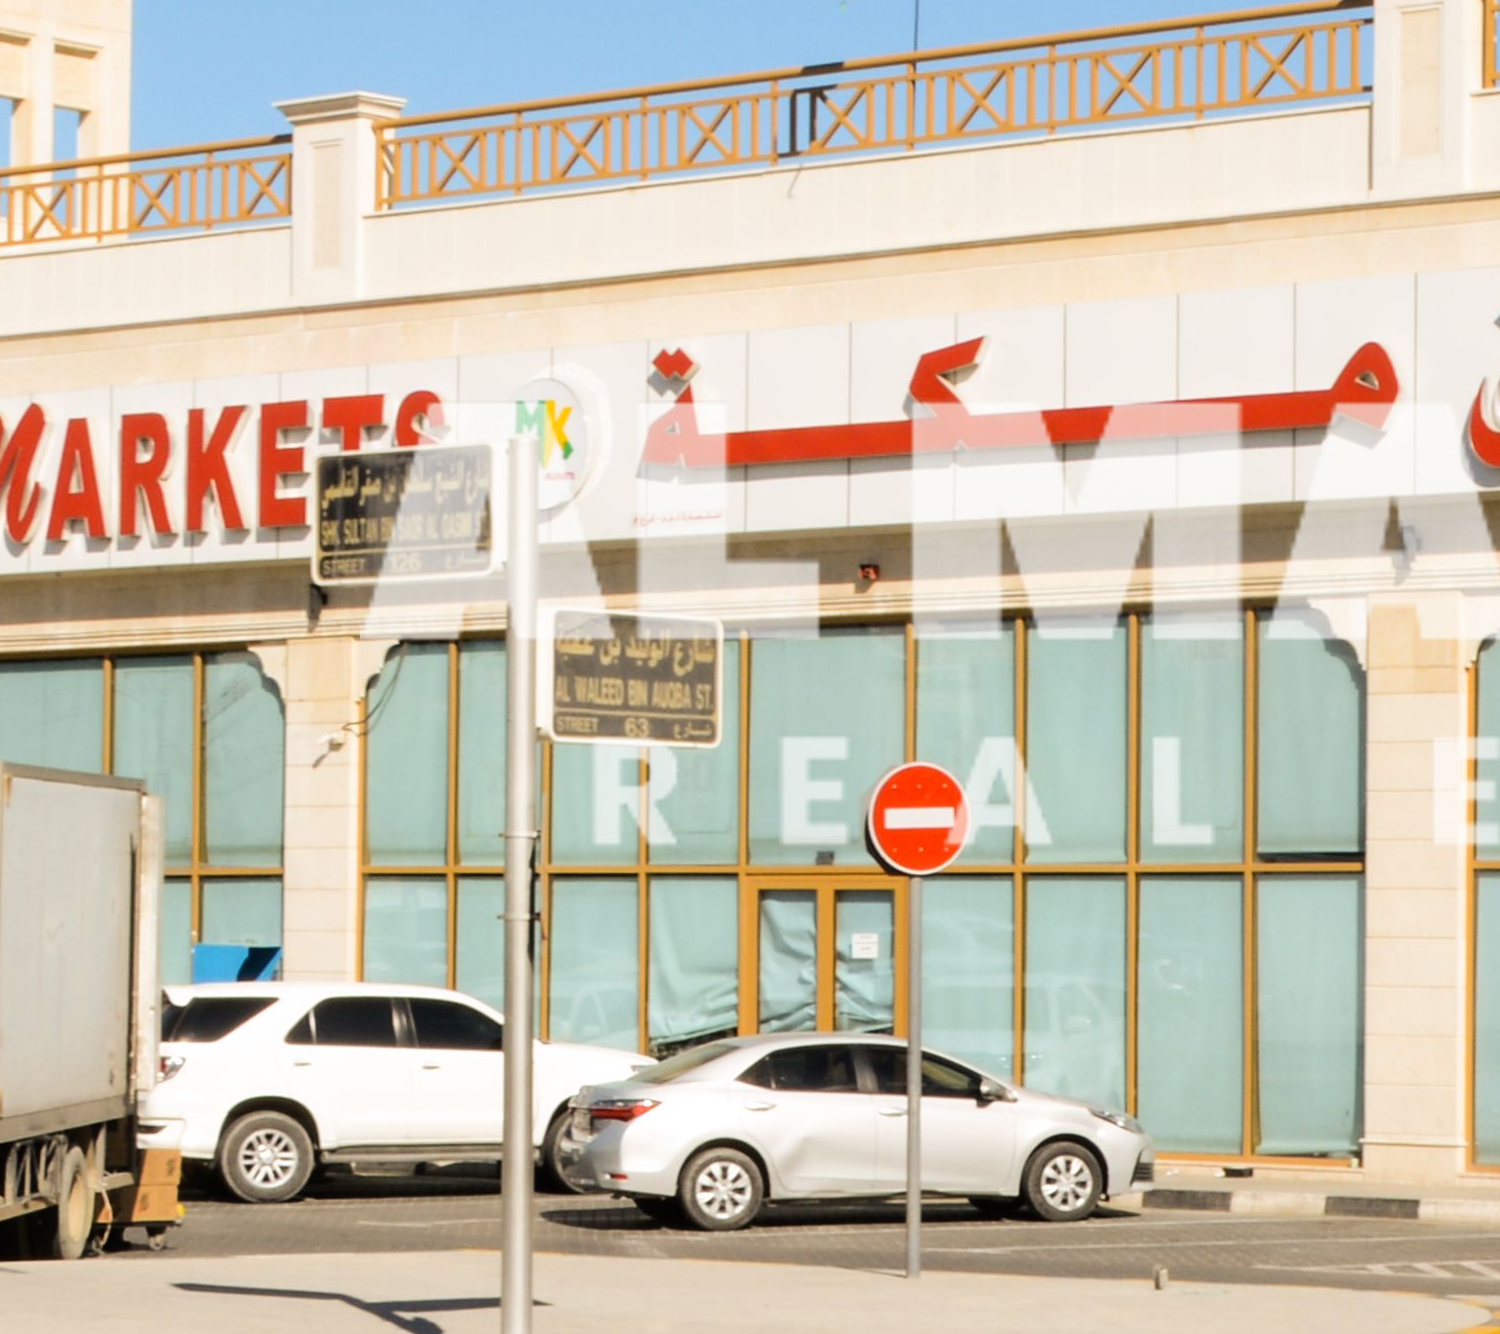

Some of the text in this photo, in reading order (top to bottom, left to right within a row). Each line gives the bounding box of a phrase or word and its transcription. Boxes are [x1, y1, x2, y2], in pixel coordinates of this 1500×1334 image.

[643, 349, 1401, 468] مكة
[322, 557, 367, 576] STREET
[554, 675, 571, 703] AL
[574, 675, 625, 706] WALEED
[627, 678, 649, 707] BIN
[555, 716, 650, 739] STREET 63
